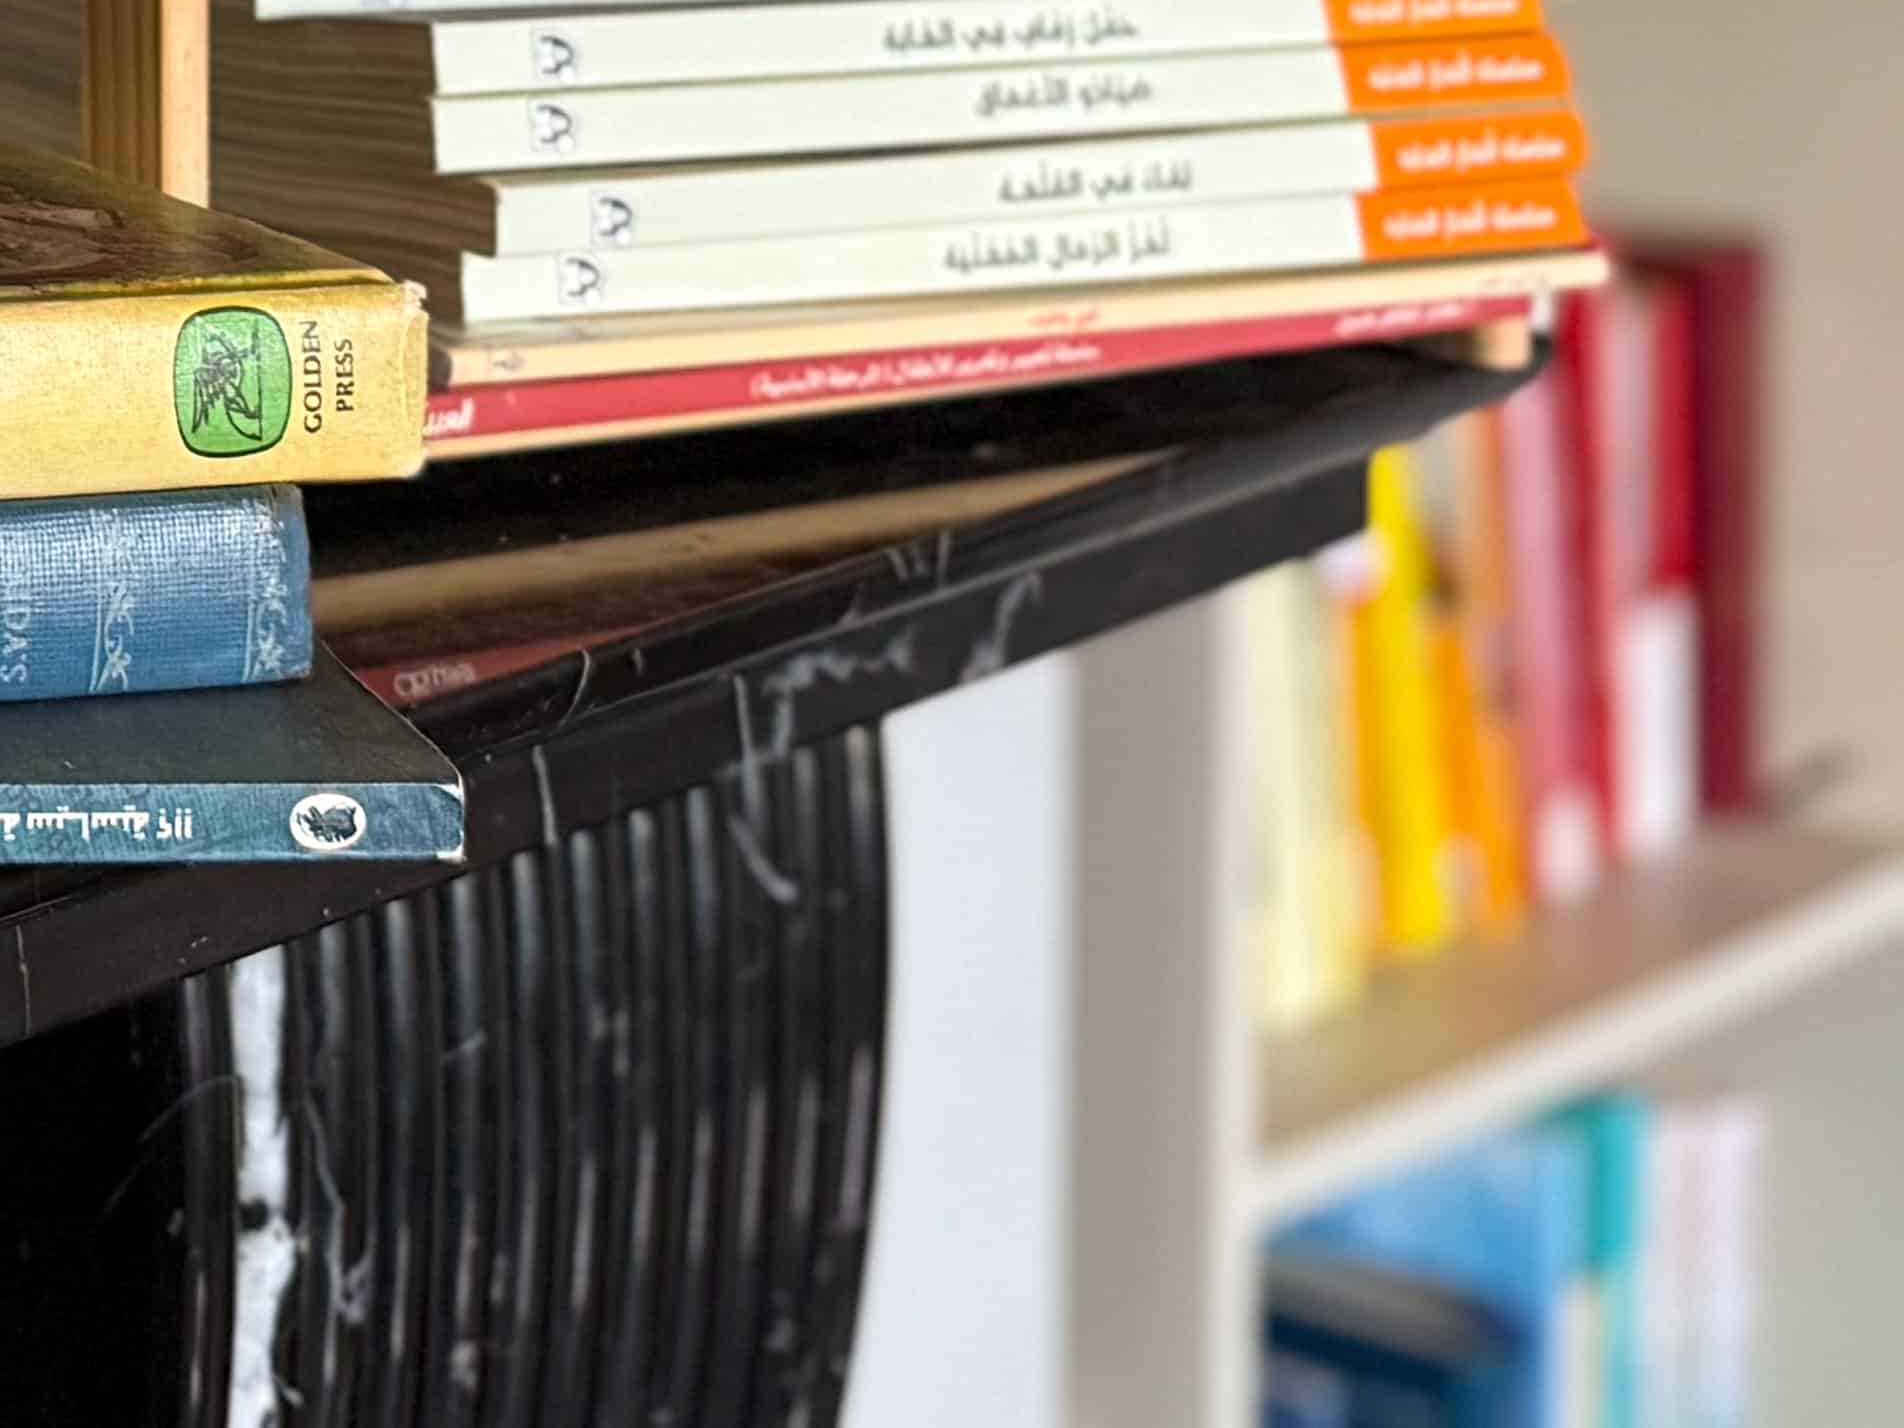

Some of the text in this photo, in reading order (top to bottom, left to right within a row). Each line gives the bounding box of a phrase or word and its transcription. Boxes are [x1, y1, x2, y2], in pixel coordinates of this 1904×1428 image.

[302, 319, 324, 435] GOLDEN
[335, 337, 355, 413] PRESS
[25, 802, 151, 842] سياسية
